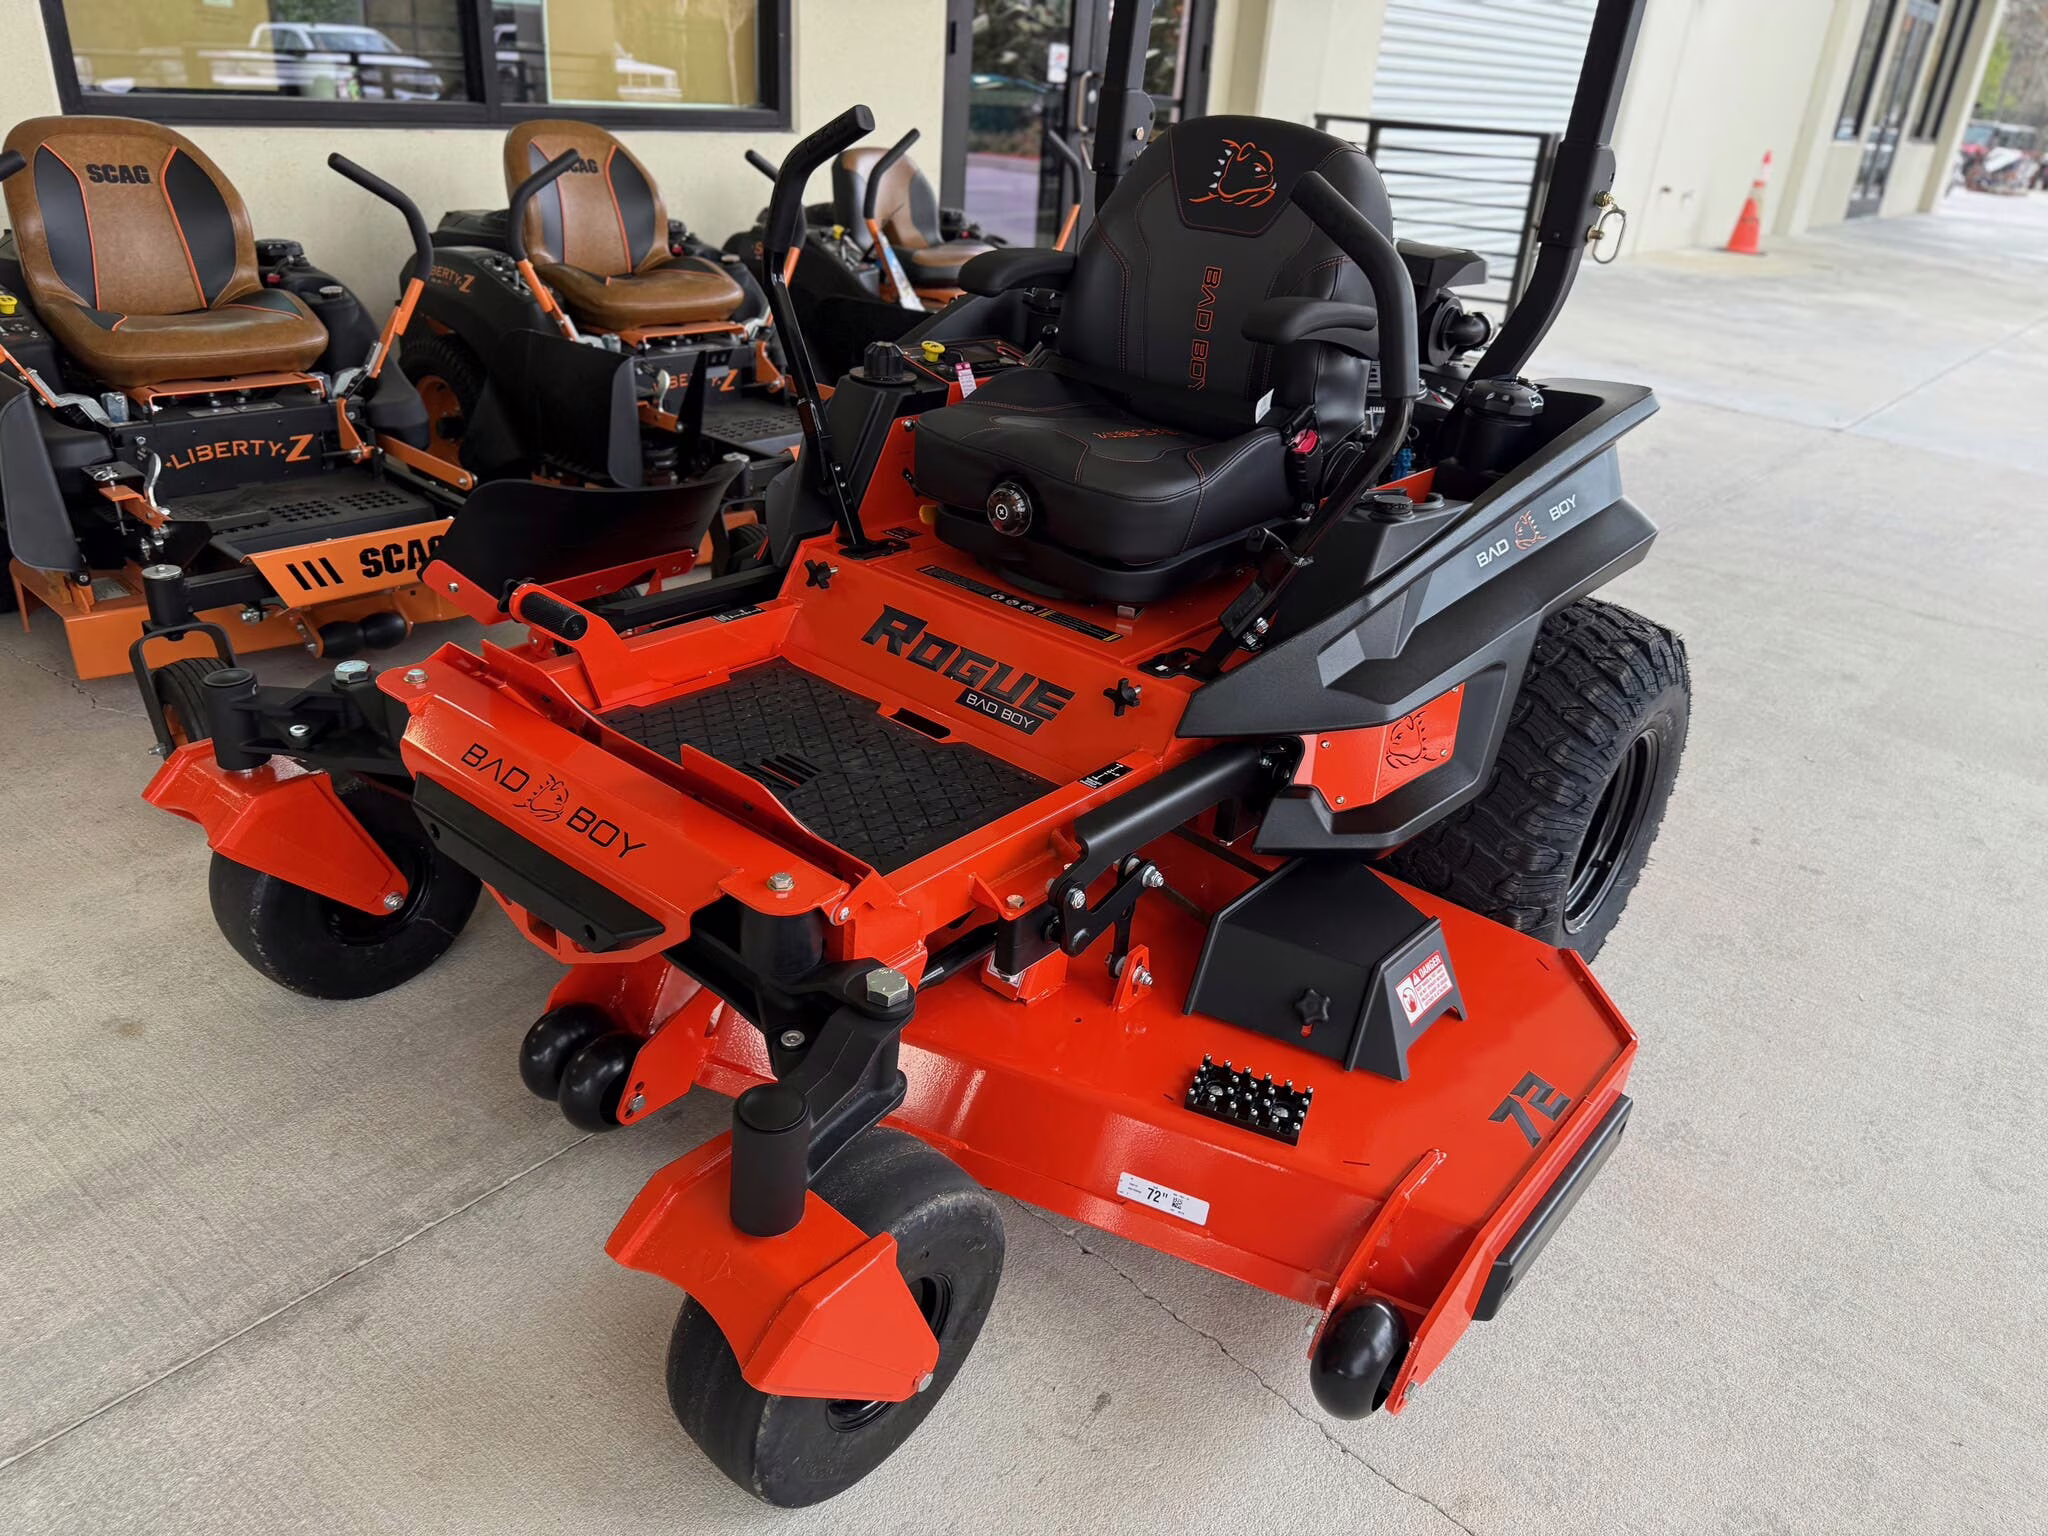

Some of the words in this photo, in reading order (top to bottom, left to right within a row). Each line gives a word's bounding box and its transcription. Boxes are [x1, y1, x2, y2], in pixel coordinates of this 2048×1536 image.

[86, 164, 152, 184] SCAG
[1198, 265, 1222, 332] BAD
[1476, 539, 1509, 567] BAD
[1549, 494, 1576, 521] BOY
[861, 604, 1076, 721] ROGUE
[966, 693, 997, 714] BAD
[1001, 708, 1036, 729] BOY
[461, 743, 531, 793] BAD
[566, 806, 647, 858] BOY
[1418, 954, 1442, 980] DANGER
[1488, 1071, 1572, 1148] 72
